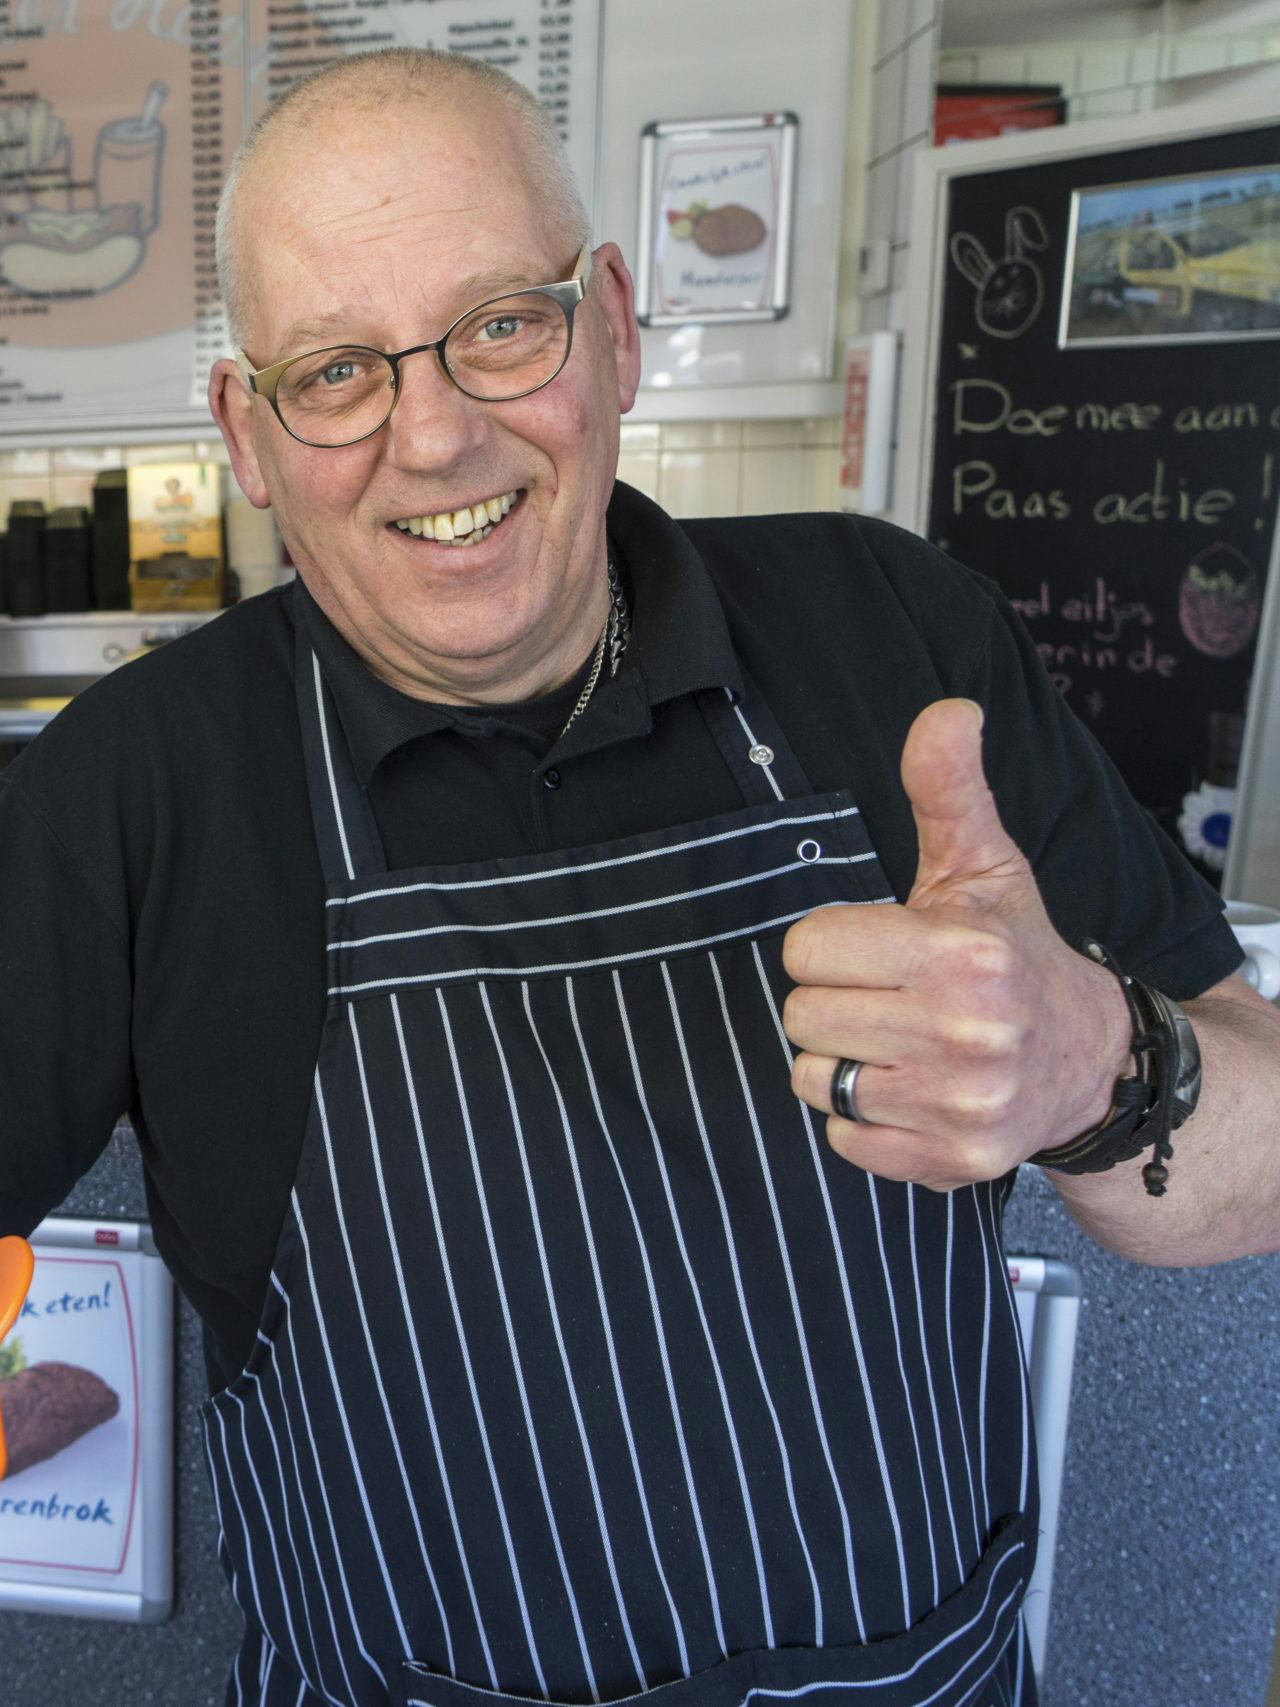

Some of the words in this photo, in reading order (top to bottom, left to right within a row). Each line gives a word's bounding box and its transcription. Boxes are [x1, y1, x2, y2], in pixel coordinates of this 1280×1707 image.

[950, 378, 1068, 437] Doe
[1076, 401, 1163, 432] mee
[1174, 401, 1259, 433] aan
[952, 459, 1071, 516] Paas
[45, 1280, 111, 1315] eten!
